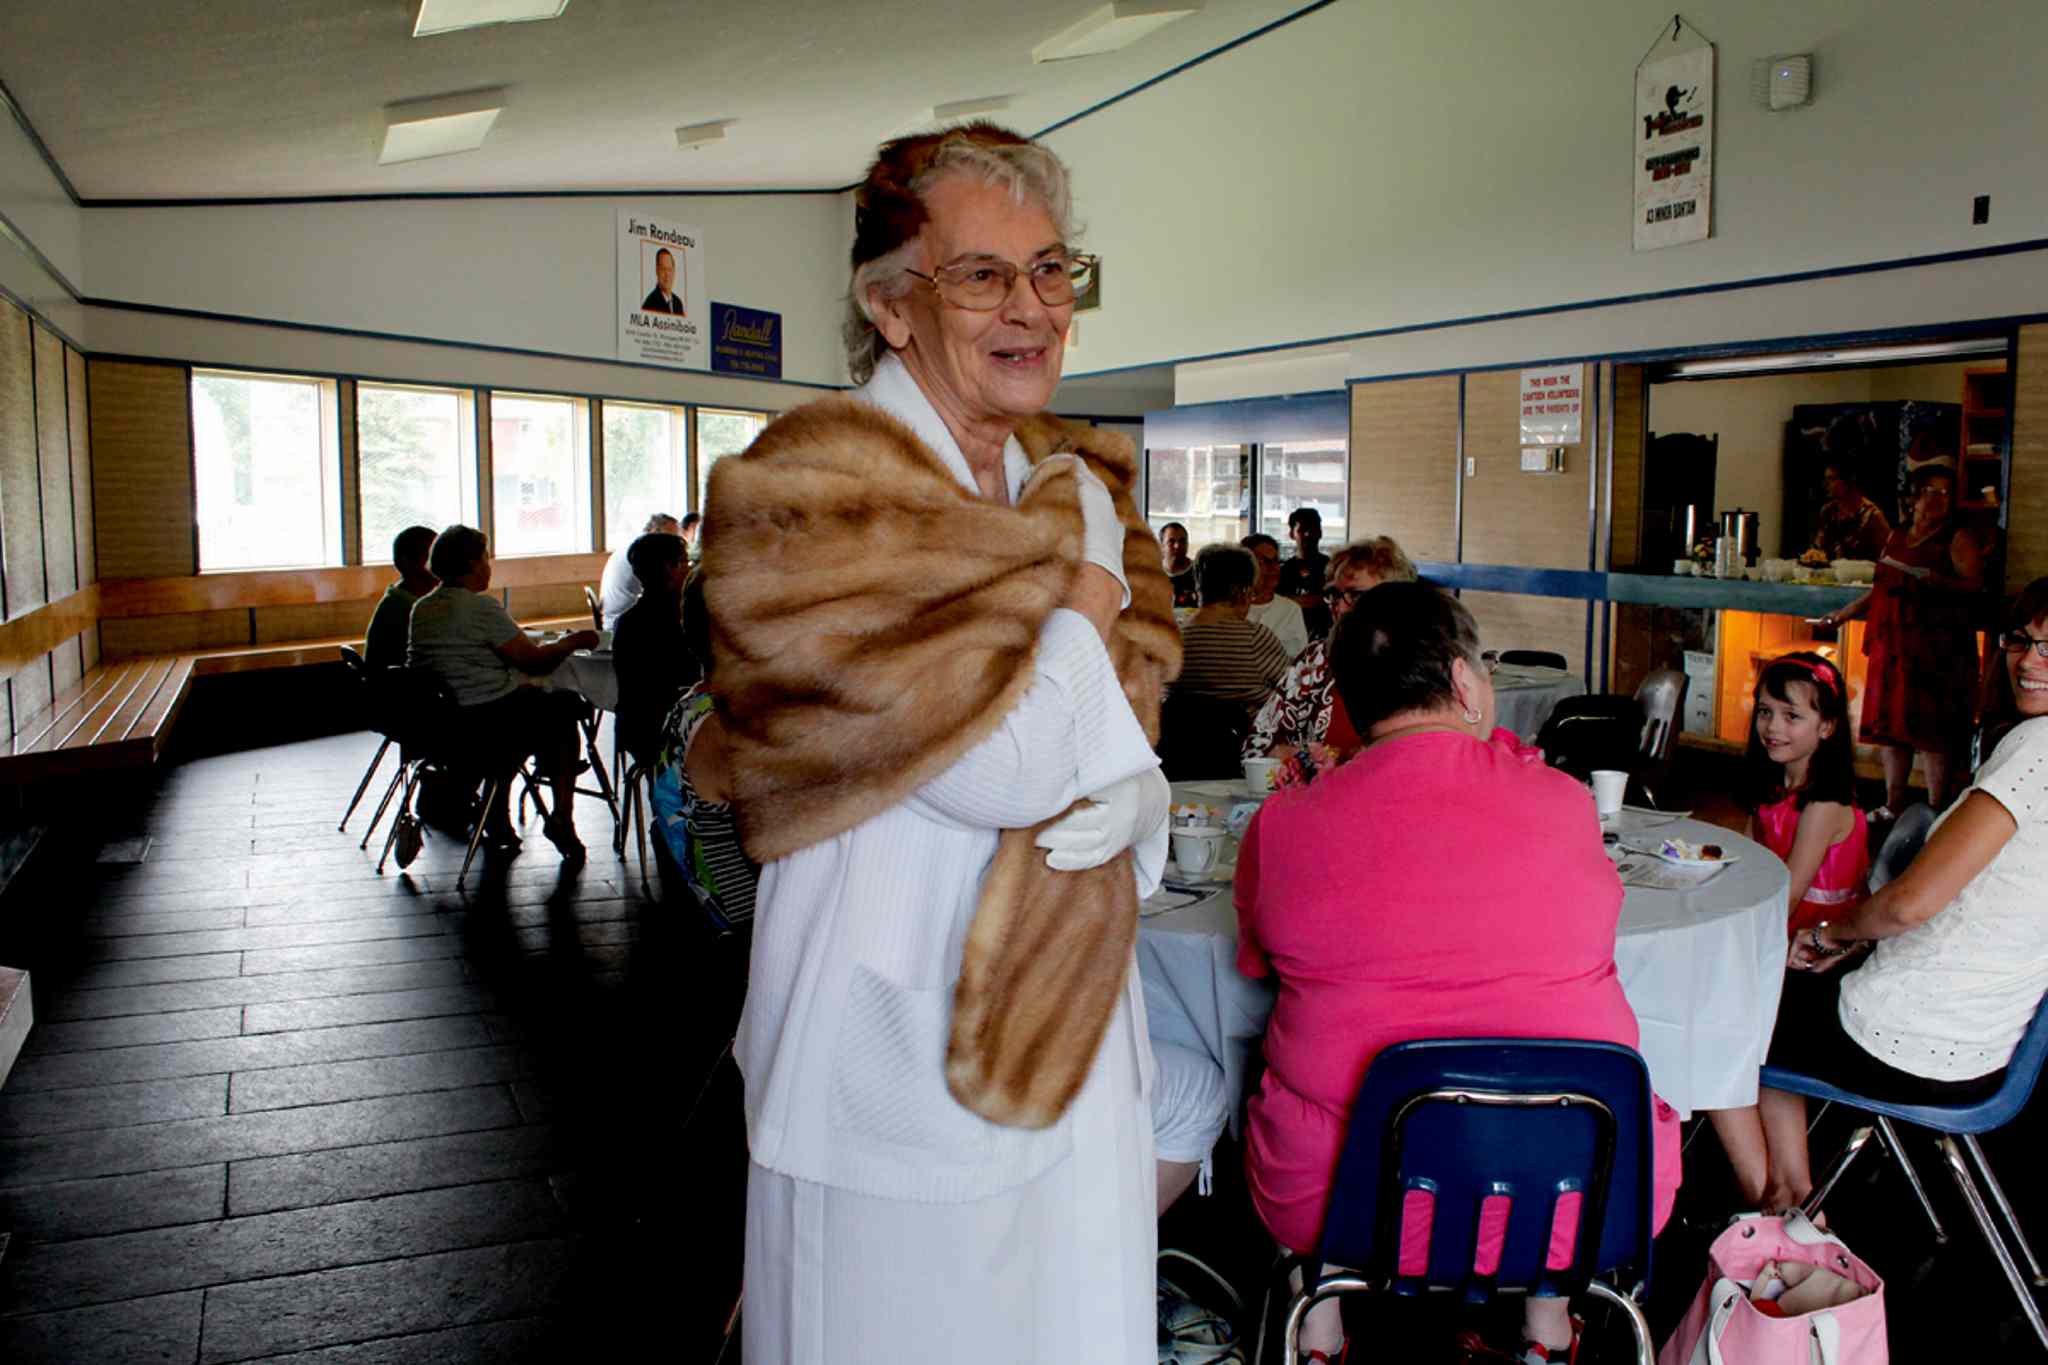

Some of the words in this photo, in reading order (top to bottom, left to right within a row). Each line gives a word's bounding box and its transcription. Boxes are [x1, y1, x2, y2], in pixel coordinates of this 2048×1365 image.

[628, 218, 647, 234] Jim
[650, 224, 696, 248] Rondeau
[630, 313, 651, 329] MLA
[652, 318, 696, 334] Assiniboia
[721, 309, 772, 341] Randall
[1559, 376, 1569, 384] THE
[1547, 389, 1579, 400] VOLUNTEERS
[1535, 404, 1545, 414] THE
[1547, 403, 1570, 414] PARENTS
